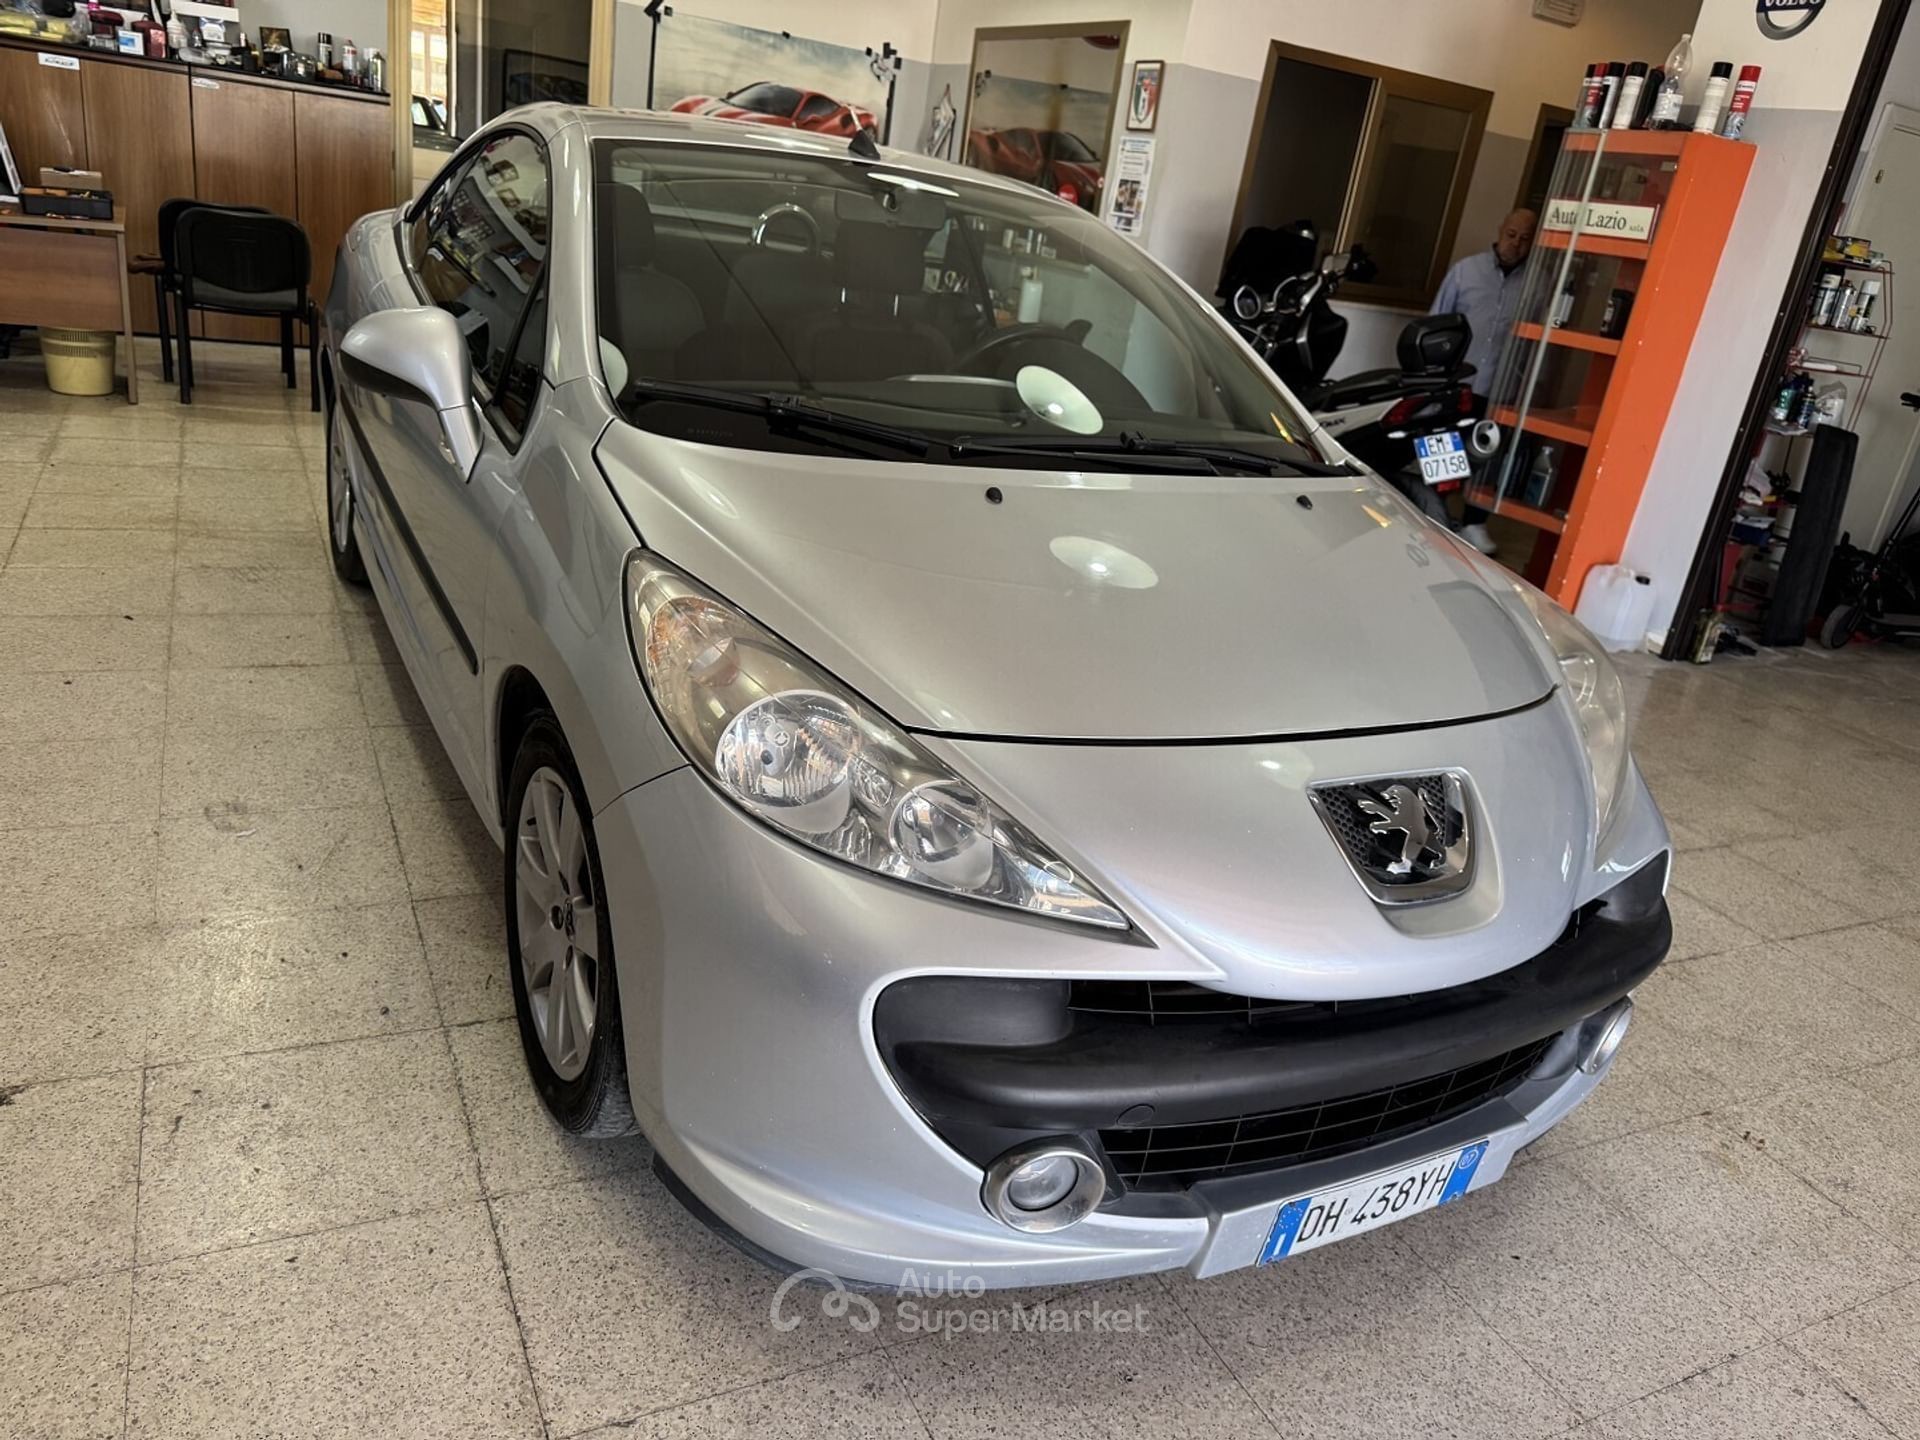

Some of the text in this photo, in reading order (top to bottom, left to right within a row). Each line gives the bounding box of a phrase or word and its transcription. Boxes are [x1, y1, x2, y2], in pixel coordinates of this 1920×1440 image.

[1585, 208, 1627, 231] Lazio
[1427, 437, 1446, 455] EM
[1423, 454, 1468, 479] 07158
[1297, 1197, 1348, 1243] DH
[1350, 1160, 1456, 1225] 438YH
